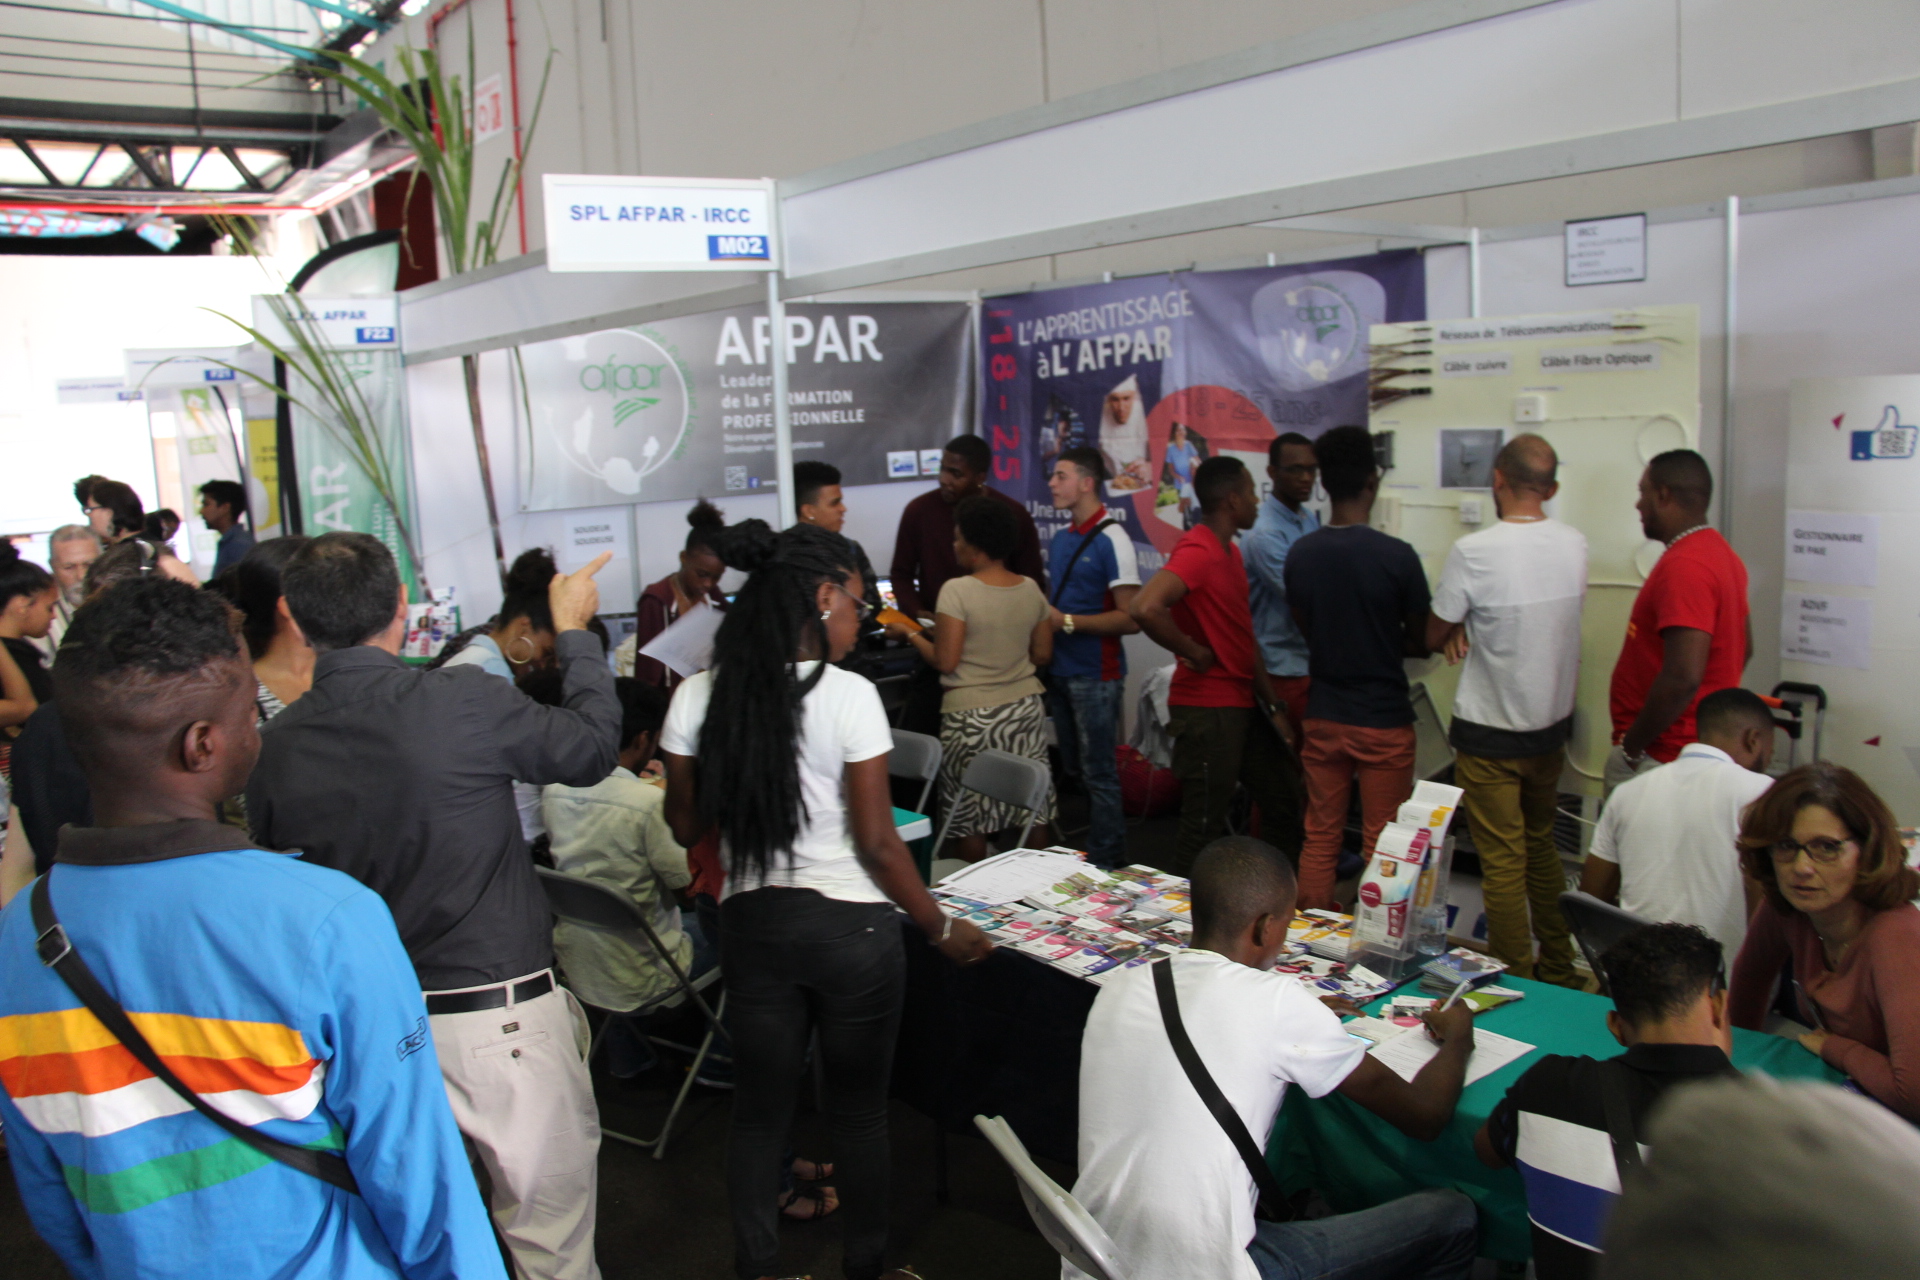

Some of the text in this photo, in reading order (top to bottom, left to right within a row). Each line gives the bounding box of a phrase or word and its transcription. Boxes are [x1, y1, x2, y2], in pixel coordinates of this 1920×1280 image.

[570, 204, 610, 221] SPL
[617, 206, 685, 222] AFPAR
[704, 208, 751, 223] IRCC
[716, 236, 764, 254] M02
[323, 309, 367, 321] AFPAR
[1017, 289, 1194, 346] L'APPRENTISSAGE
[363, 329, 390, 340] F22
[715, 315, 884, 366] AFPAR
[1443, 359, 1508, 372] Câble cuivre
[1541, 353, 1653, 368] Câble Fibre Optique
[579, 353, 668, 398] afpar
[720, 373, 774, 388] Leader
[721, 390, 853, 408] de la FRMATION
[722, 409, 865, 429] PROFEIONNELLE
[575, 525, 609, 534] SOUDEUR
[1793, 528, 1864, 543] GESTIONNAIRE
